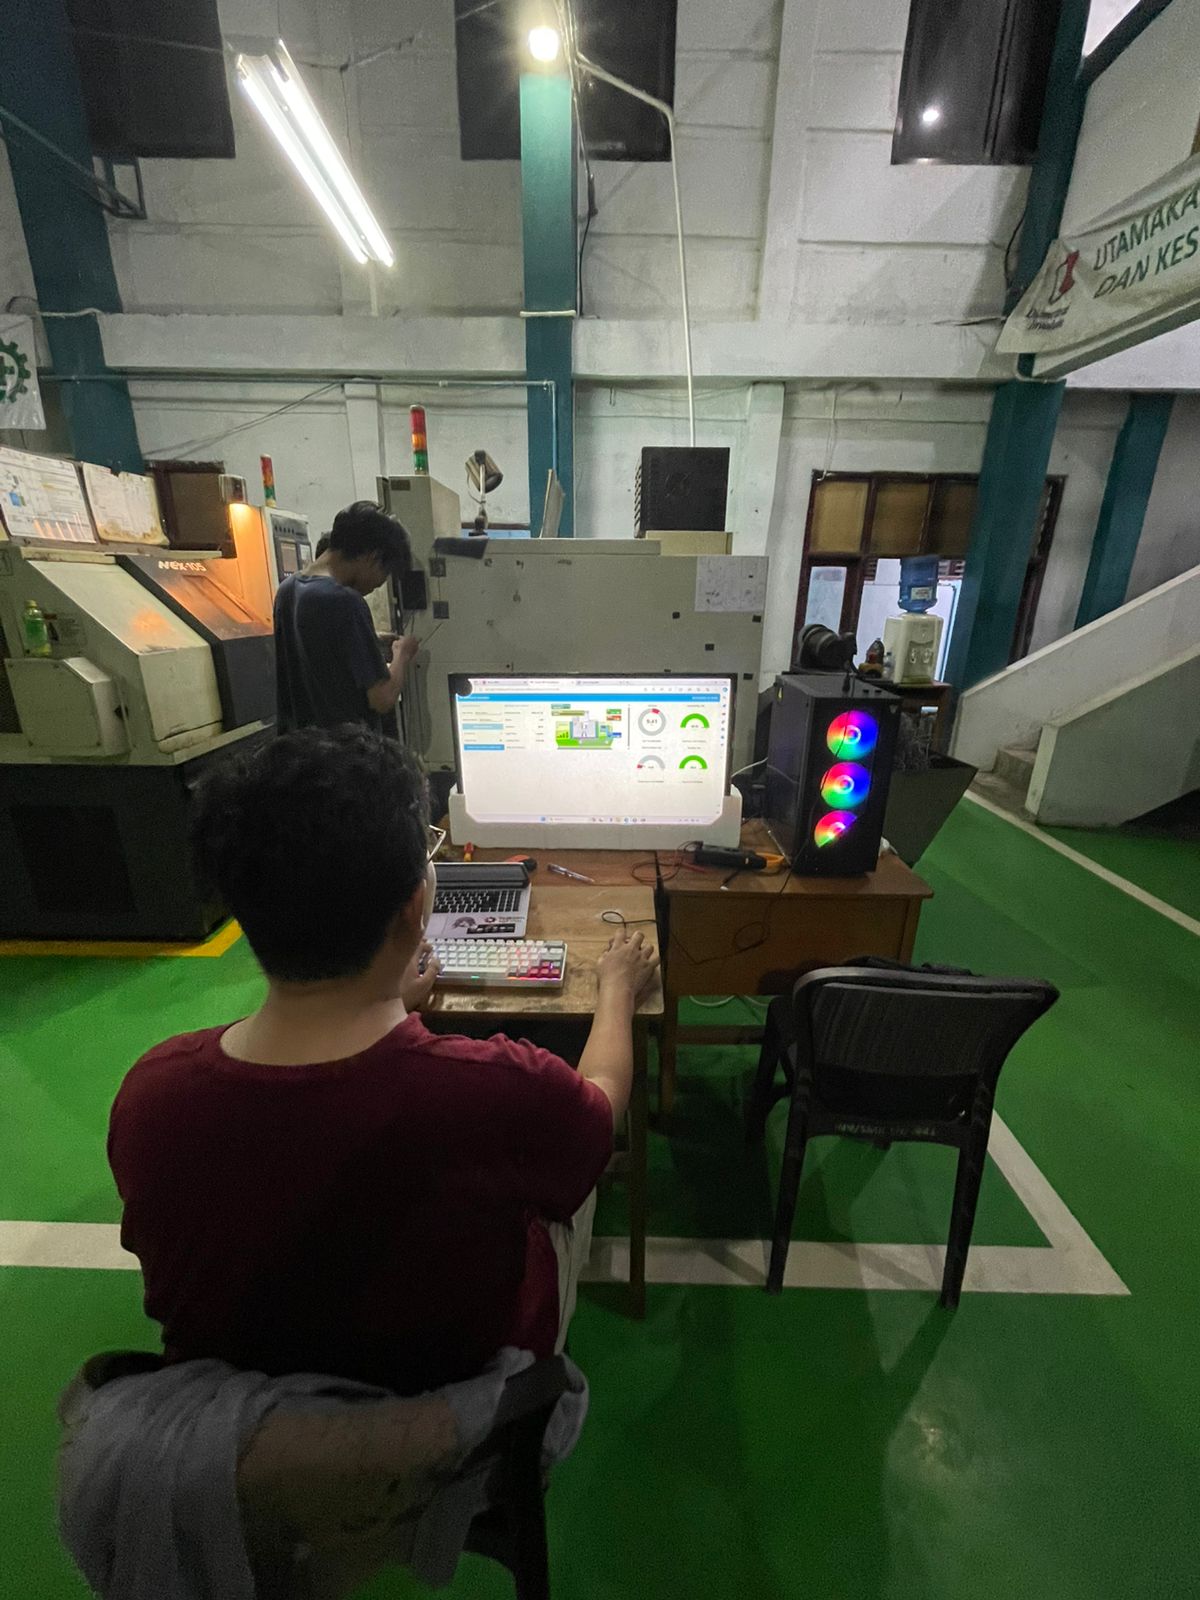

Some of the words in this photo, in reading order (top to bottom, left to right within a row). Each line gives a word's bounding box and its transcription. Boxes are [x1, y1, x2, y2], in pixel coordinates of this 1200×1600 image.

[1093, 182, 1200, 271] UTAMAKA
[1093, 254, 1150, 299] DAN
[1155, 225, 1199, 275] KES
